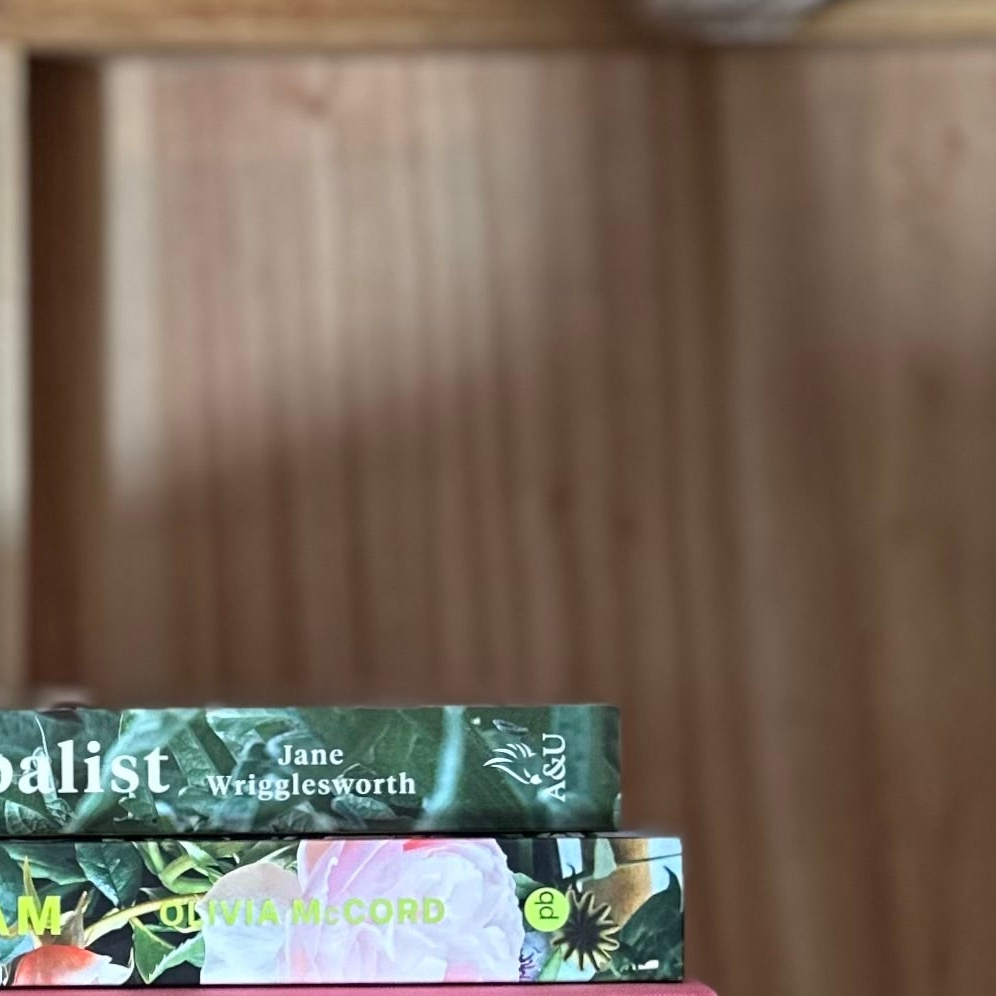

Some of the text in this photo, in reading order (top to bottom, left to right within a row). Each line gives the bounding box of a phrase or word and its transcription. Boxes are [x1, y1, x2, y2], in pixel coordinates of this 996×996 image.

[277, 744, 344, 767] Jane
[541, 732, 566, 802] A&U
[206, 771, 417, 800] Wrigglesworth
[159, 897, 446, 928] OLIVIA McCORD
